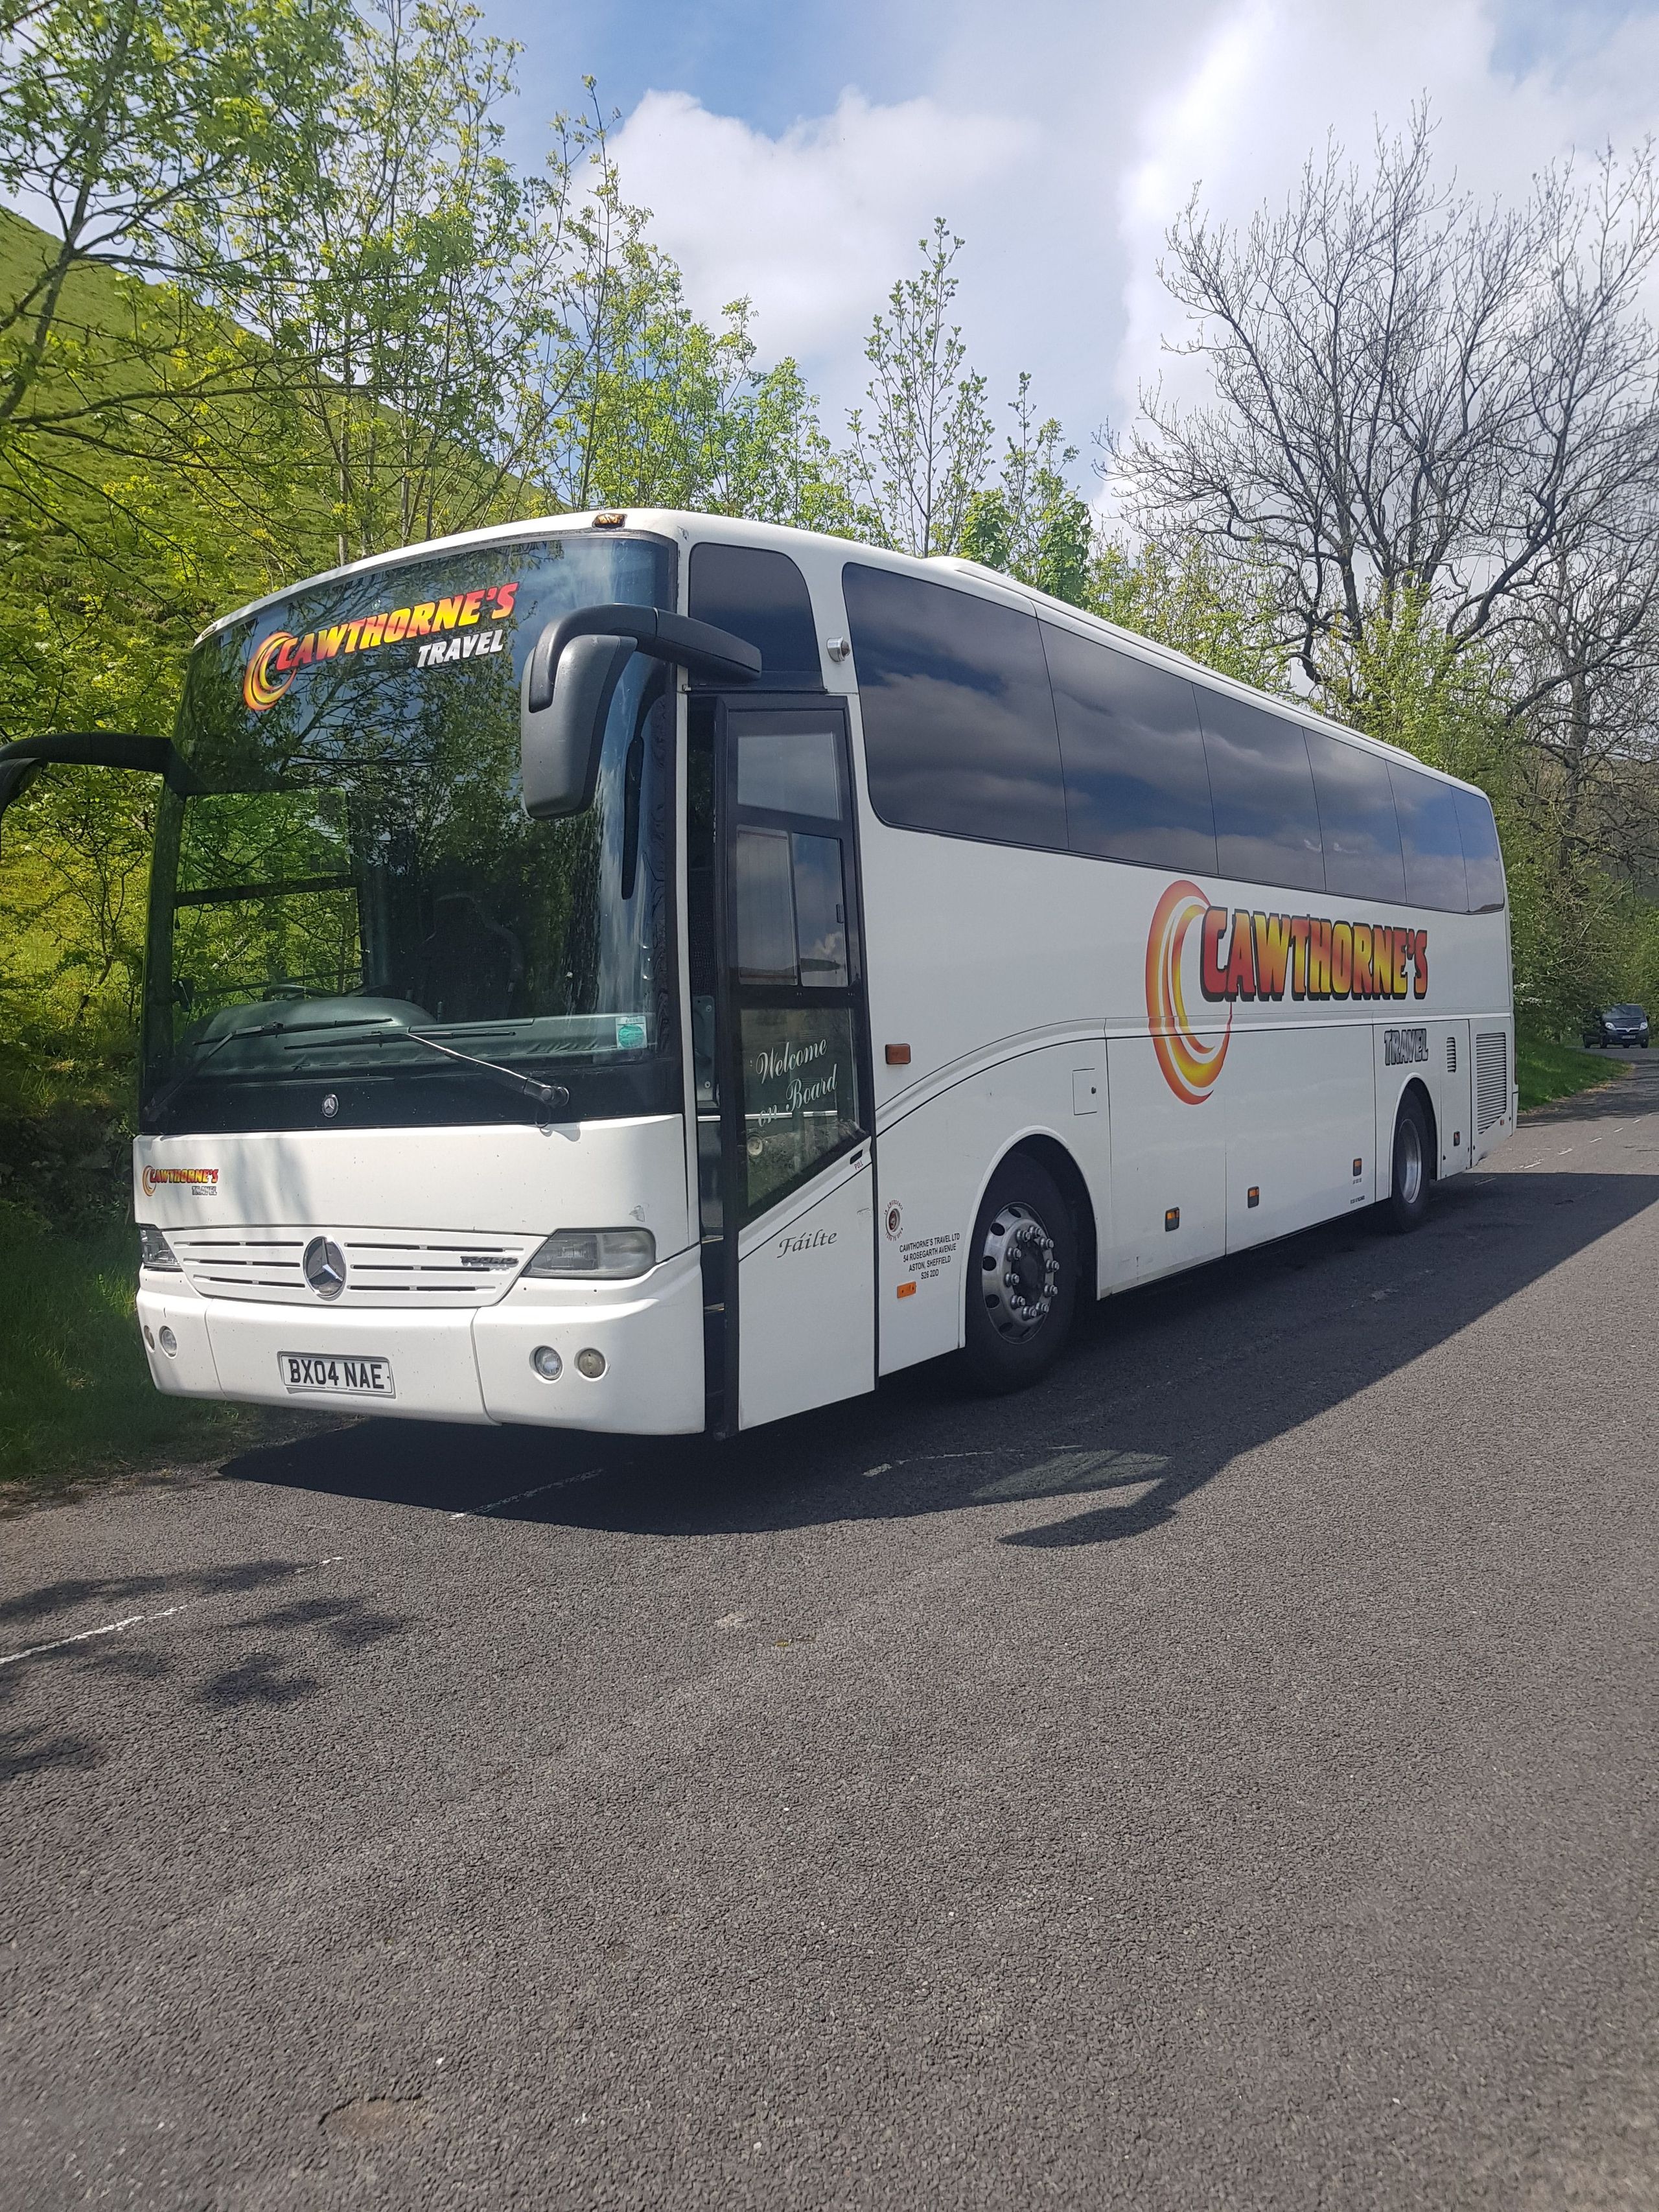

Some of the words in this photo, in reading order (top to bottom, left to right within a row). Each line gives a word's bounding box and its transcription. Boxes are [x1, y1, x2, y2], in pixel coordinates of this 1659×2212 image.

[274, 581, 519, 671] CAWTHORNE'S
[417, 629, 504, 668] TRAVEL
[1200, 905, 1428, 1003] CAWTHORNE'S
[756, 1039, 827, 1084] Welcome
[1384, 1028, 1429, 1066] TRAVEL
[758, 1104, 779, 1127] on
[785, 1063, 837, 1112] Board
[150, 1169, 219, 1183] CAWTHORNE'S
[192, 1185, 218, 1196] TRAVEL
[776, 1229, 838, 1259] Fáilte
[899, 1238, 933, 1253] CAWTHORNE'S
[934, 1234, 951, 1245] TRAVEL
[951, 1233, 960, 1241] LTD
[903, 1254, 909, 1263] 54
[909, 1247, 938, 1261] ROSEGARTH
[938, 1242, 957, 1253] AVENUE
[909, 1261, 926, 1272] ASTON,
[927, 1255, 951, 1268] SHEFFIELD
[921, 1271, 929, 1279] S26
[288, 1358, 340, 1386] BX04
[343, 1362, 385, 1389] NAE
